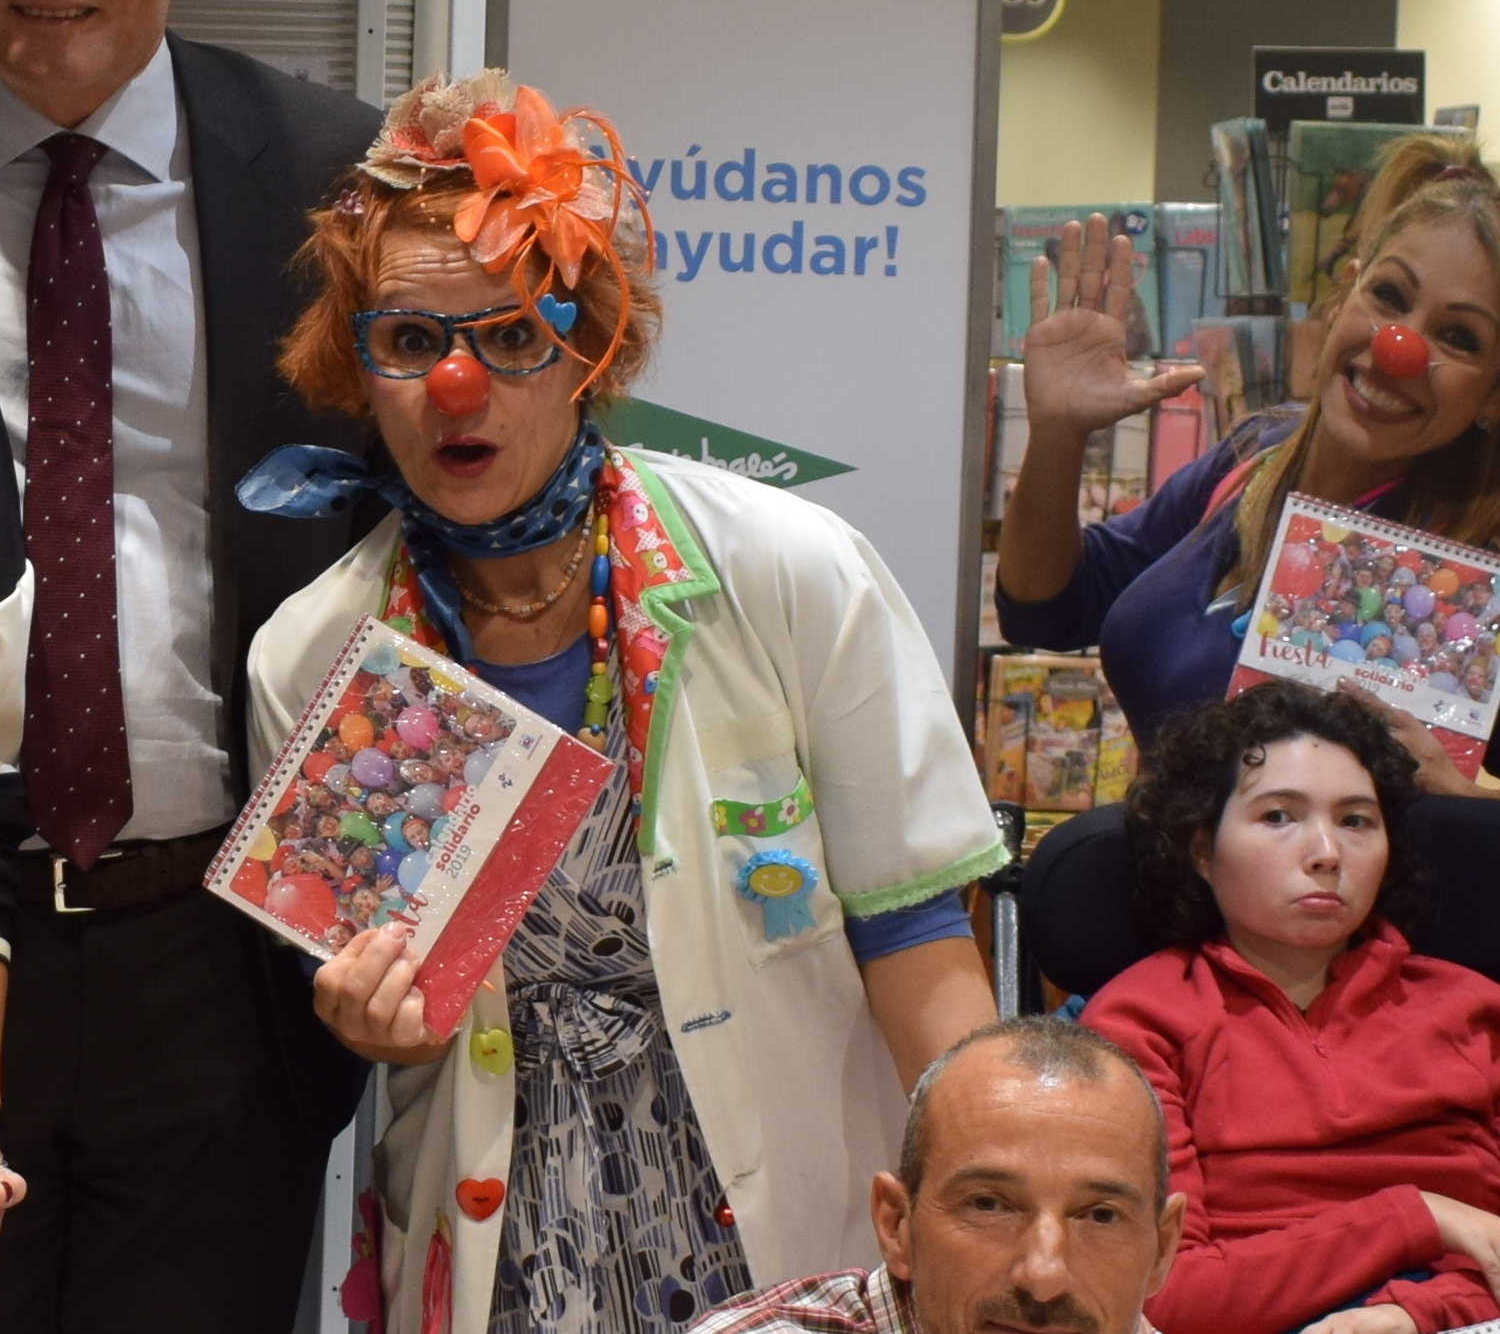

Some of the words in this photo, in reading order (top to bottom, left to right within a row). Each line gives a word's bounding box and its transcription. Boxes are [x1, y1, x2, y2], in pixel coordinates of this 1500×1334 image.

[1261, 69, 1419, 94] Calendarios
[1257, 630, 1335, 669] Fiesta
[434, 801, 482, 873] solidario
[445, 843, 473, 880] 2019
